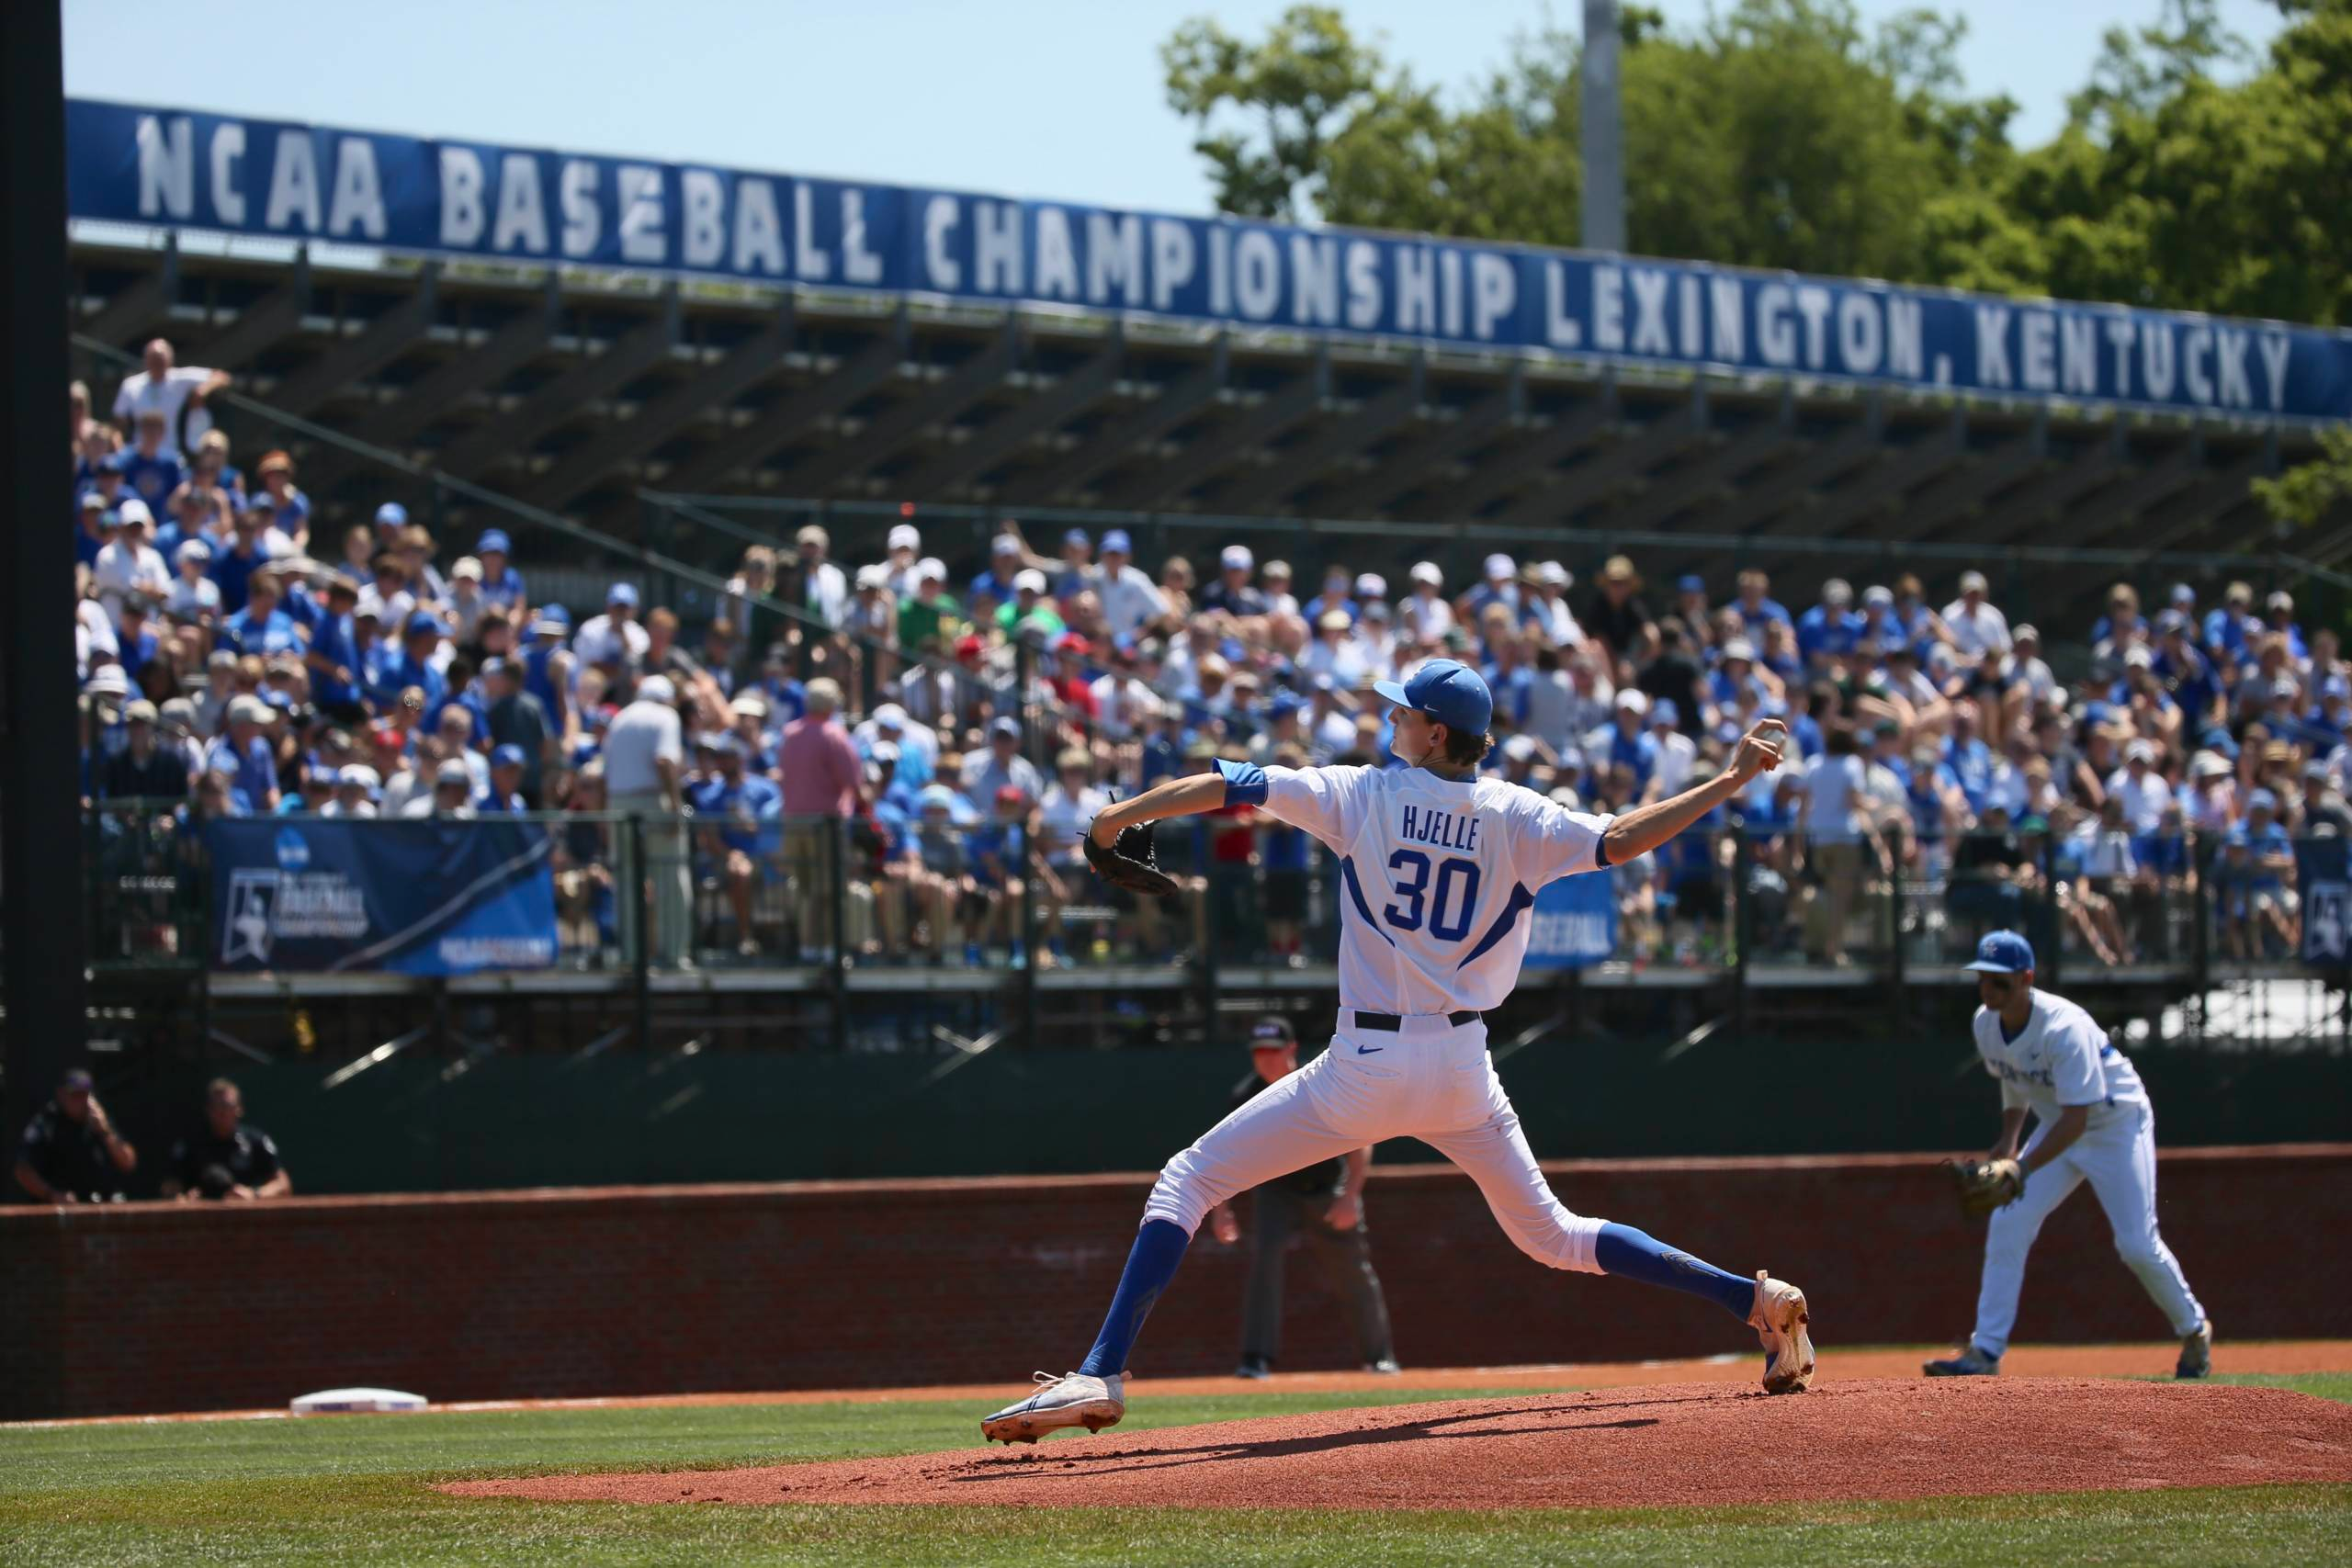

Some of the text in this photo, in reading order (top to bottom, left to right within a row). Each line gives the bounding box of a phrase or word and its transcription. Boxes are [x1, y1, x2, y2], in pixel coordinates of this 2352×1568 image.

[137, 115, 2291, 411] NCAA BASEBALL CHAMPIONSHIP LEXINGTON, KENTUCKY
[1402, 805, 1479, 852] HJELLE
[1383, 848, 1481, 942] 30
